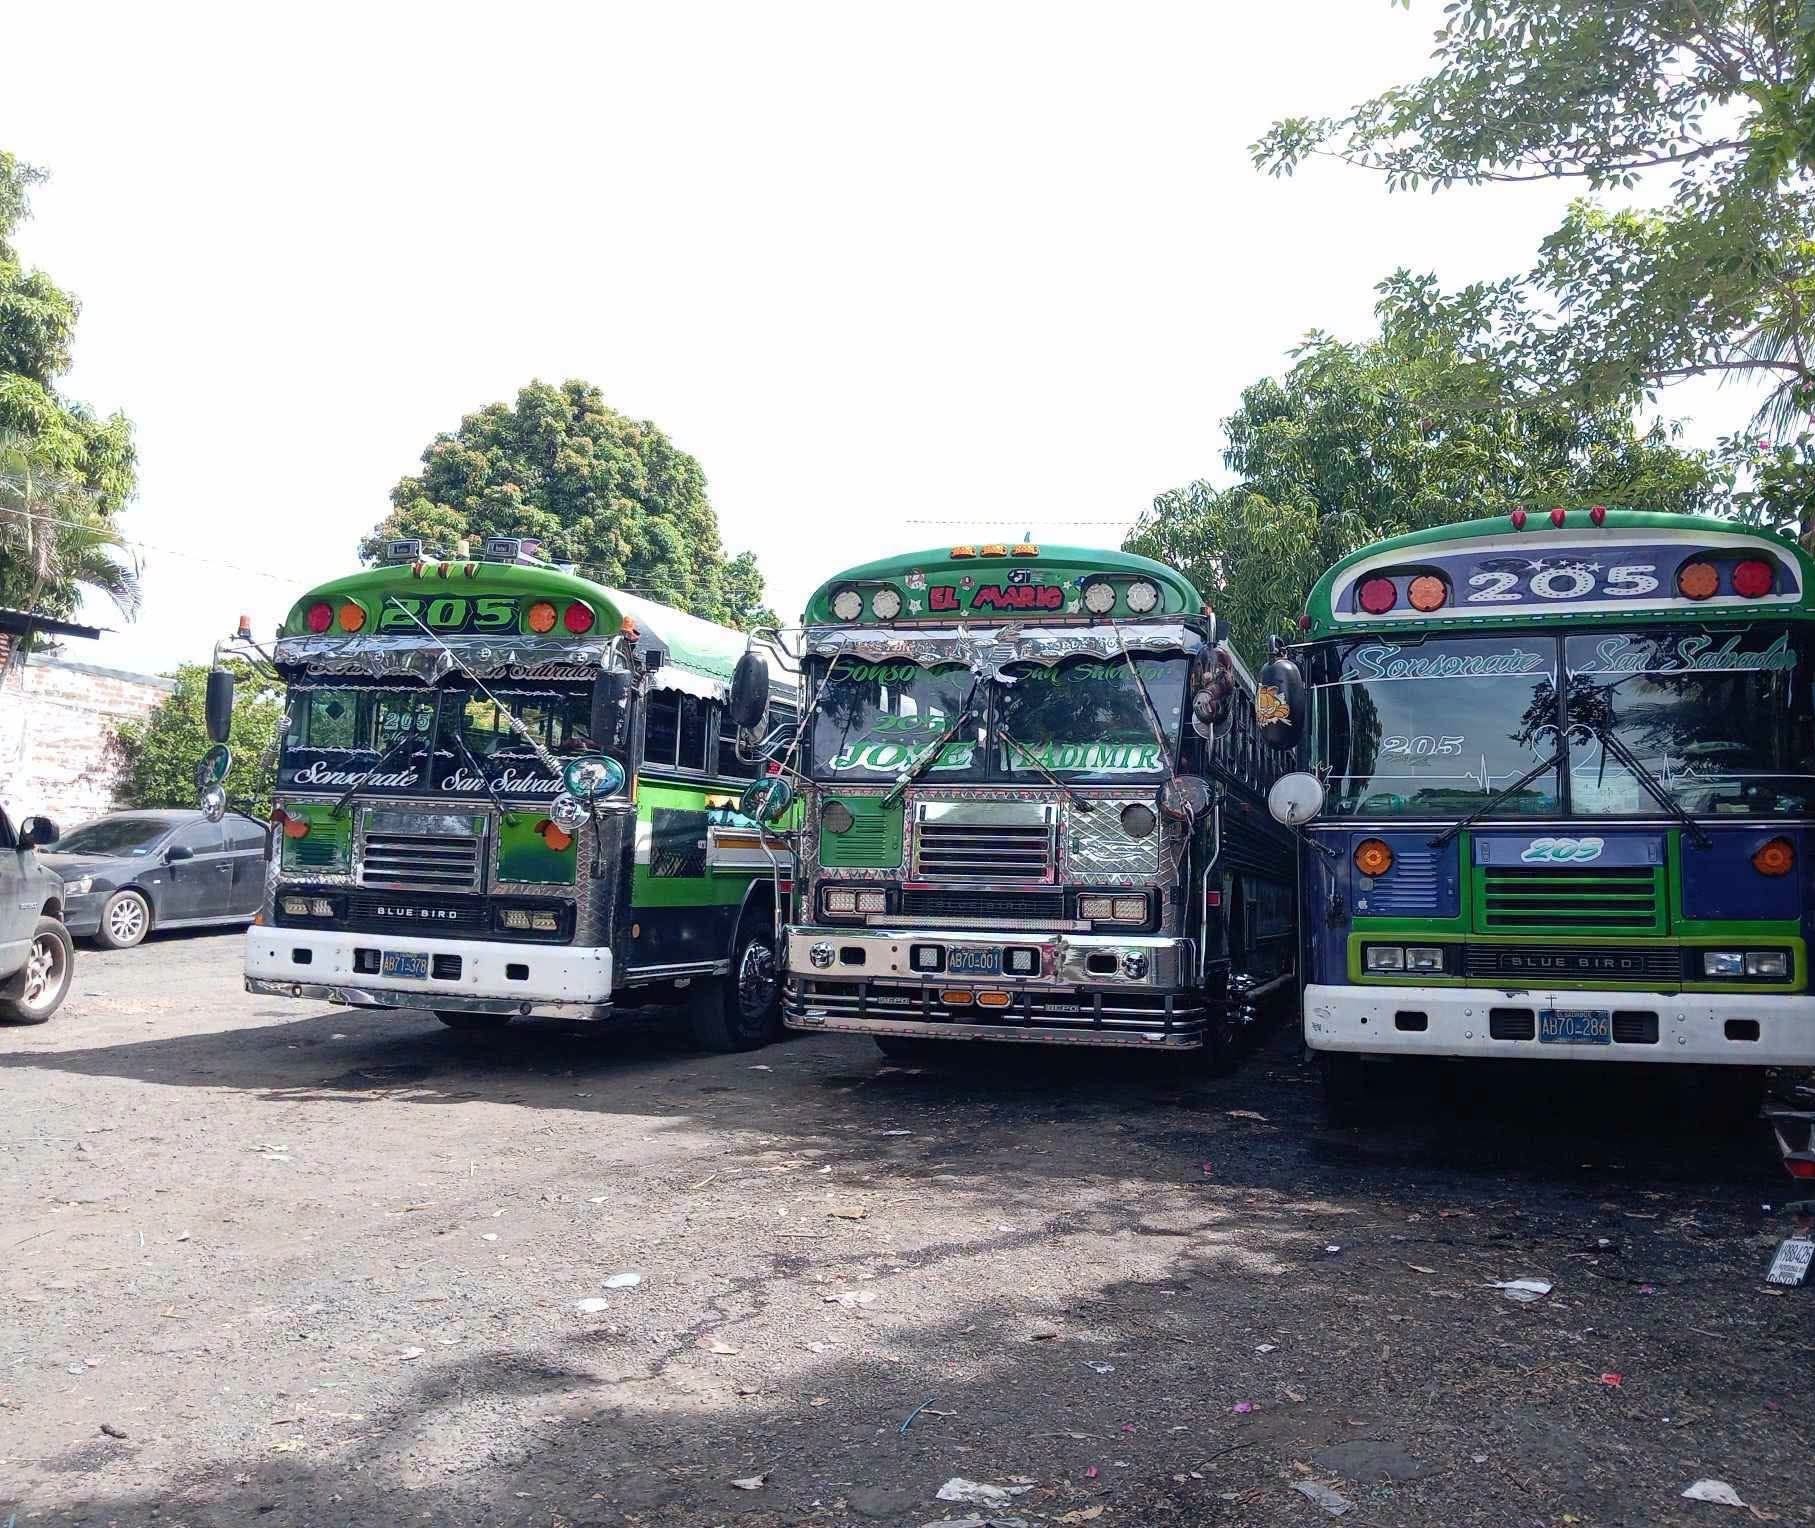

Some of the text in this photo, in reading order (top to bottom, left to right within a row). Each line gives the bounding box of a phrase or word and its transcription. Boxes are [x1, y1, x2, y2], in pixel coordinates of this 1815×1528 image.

[1467, 565, 1659, 602] 205
[929, 584, 1065, 612] EL MARIO
[380, 598, 519, 632] 205
[1341, 646, 1545, 682] Sonsonate
[1579, 634, 1651, 673] San
[384, 712, 431, 731] 205
[1381, 735, 1465, 756] 205
[441, 767, 485, 791] San
[491, 768, 567, 792] Salvado
[1521, 837, 1605, 863] 205
[377, 906, 457, 919] BLUE BIRD
[1511, 957, 1633, 968] BLUE BIRD
[1541, 1017, 1608, 1036] AB70-286
